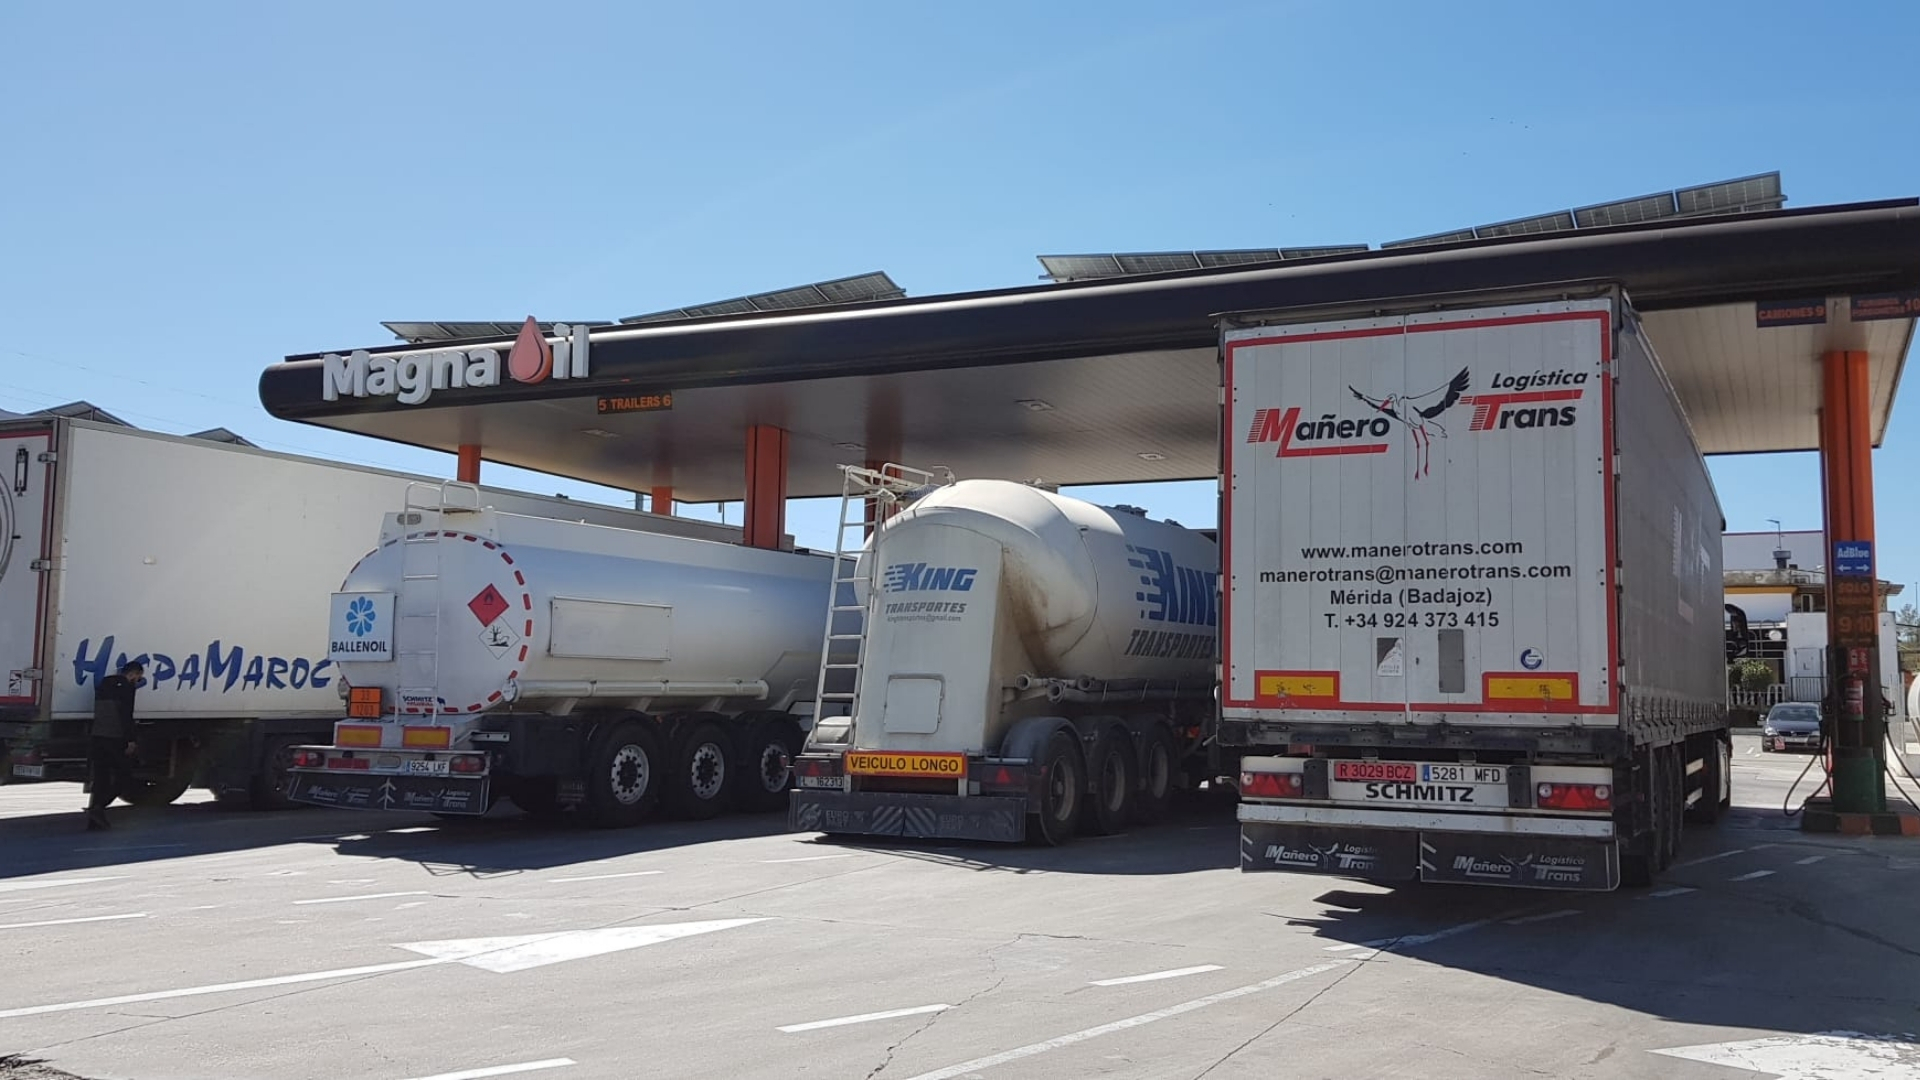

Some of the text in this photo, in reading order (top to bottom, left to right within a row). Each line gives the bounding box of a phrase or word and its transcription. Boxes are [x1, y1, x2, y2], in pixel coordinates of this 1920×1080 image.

[1815, 306, 1825, 317] 9
[322, 349, 501, 405] Magna
[1491, 369, 1588, 391] Logística
[599, 395, 671, 411] 5 TRAILERS 6
[1246, 388, 1583, 457] Mañero Trans
[1301, 541, 1523, 559] www.manerotrans.com
[1837, 546, 1870, 559] AdBlue
[884, 562, 978, 592] KING
[1259, 564, 1572, 584] manerotrans@manerotrans.com
[1330, 587, 1493, 608] Mérida (Badajoz)
[885, 602, 967, 614] TRANSPORTES
[1325, 612, 1499, 628] T. +34 924 373 415
[331, 641, 387, 653] BALLENOIL
[411, 761, 429, 772] 9254
[850, 756, 959, 772] VEICULO LONGO
[1340, 763, 1412, 780] R 3029 BCZ
[1431, 766, 1500, 782] 5281 MFD
[1365, 783, 1475, 802] SCHMITZ
[1265, 845, 1378, 869] Mañero Tran
[1453, 855, 1583, 882] Mañero Trans
